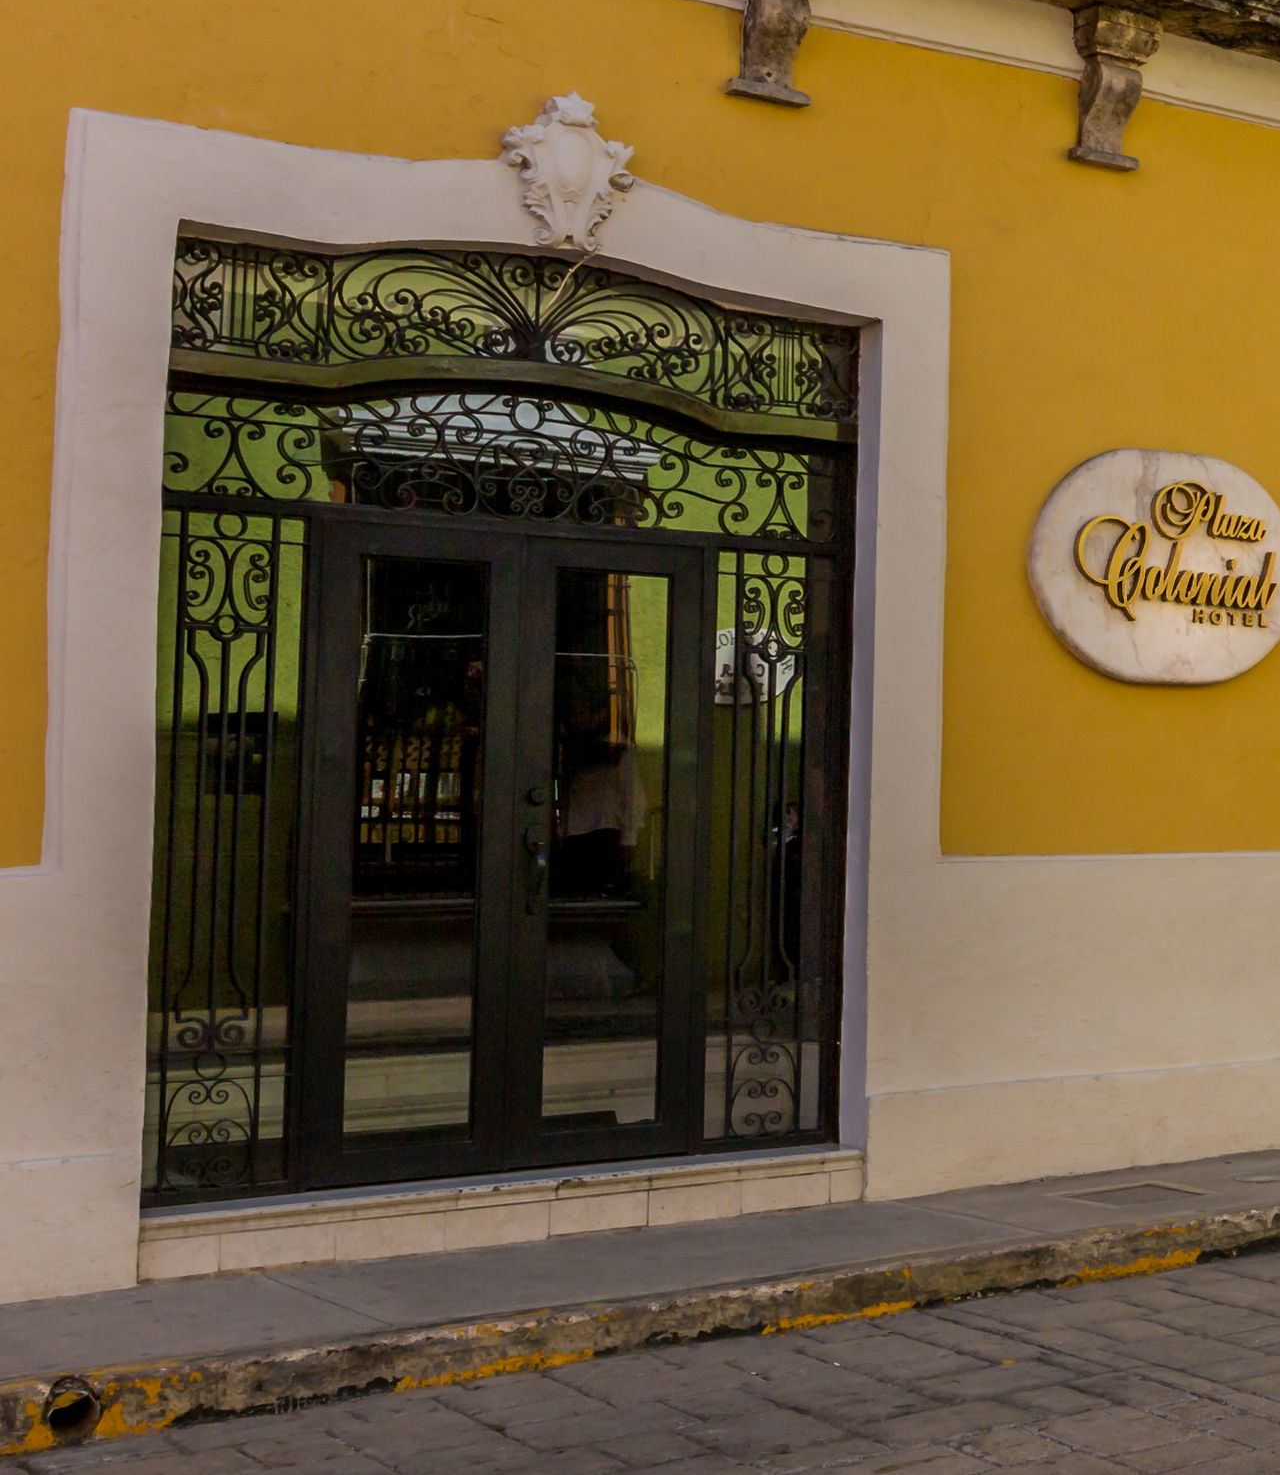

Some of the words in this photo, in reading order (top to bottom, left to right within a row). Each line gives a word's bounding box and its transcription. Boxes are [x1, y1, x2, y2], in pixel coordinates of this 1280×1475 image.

[1152, 480, 1266, 541] Plaza
[1075, 515, 1279, 621] Colonial
[1193, 609, 1268, 628] HOTEL
